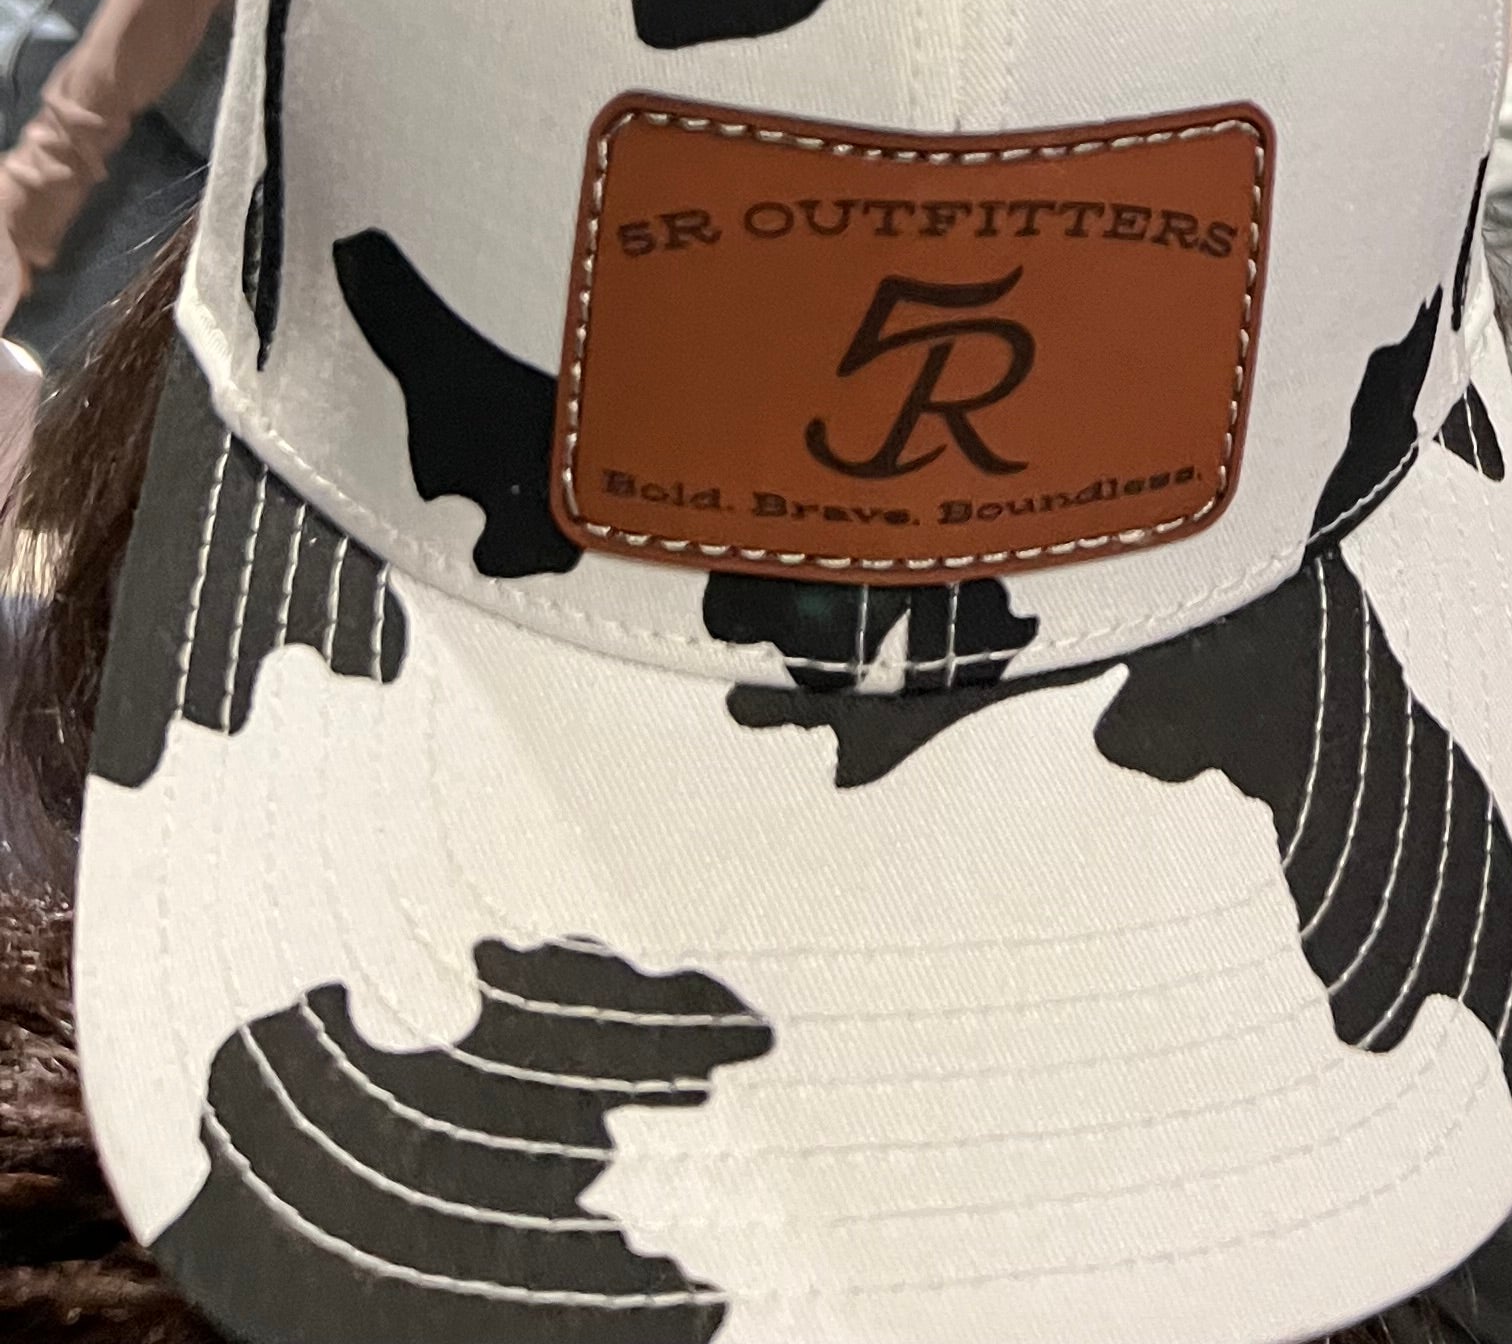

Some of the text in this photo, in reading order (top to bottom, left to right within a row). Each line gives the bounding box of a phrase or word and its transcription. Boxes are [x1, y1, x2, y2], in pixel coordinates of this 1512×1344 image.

[617, 198, 1238, 259] 5R OUTFITTERS
[602, 465, 1203, 527] Bold. Brave. Boundless.
